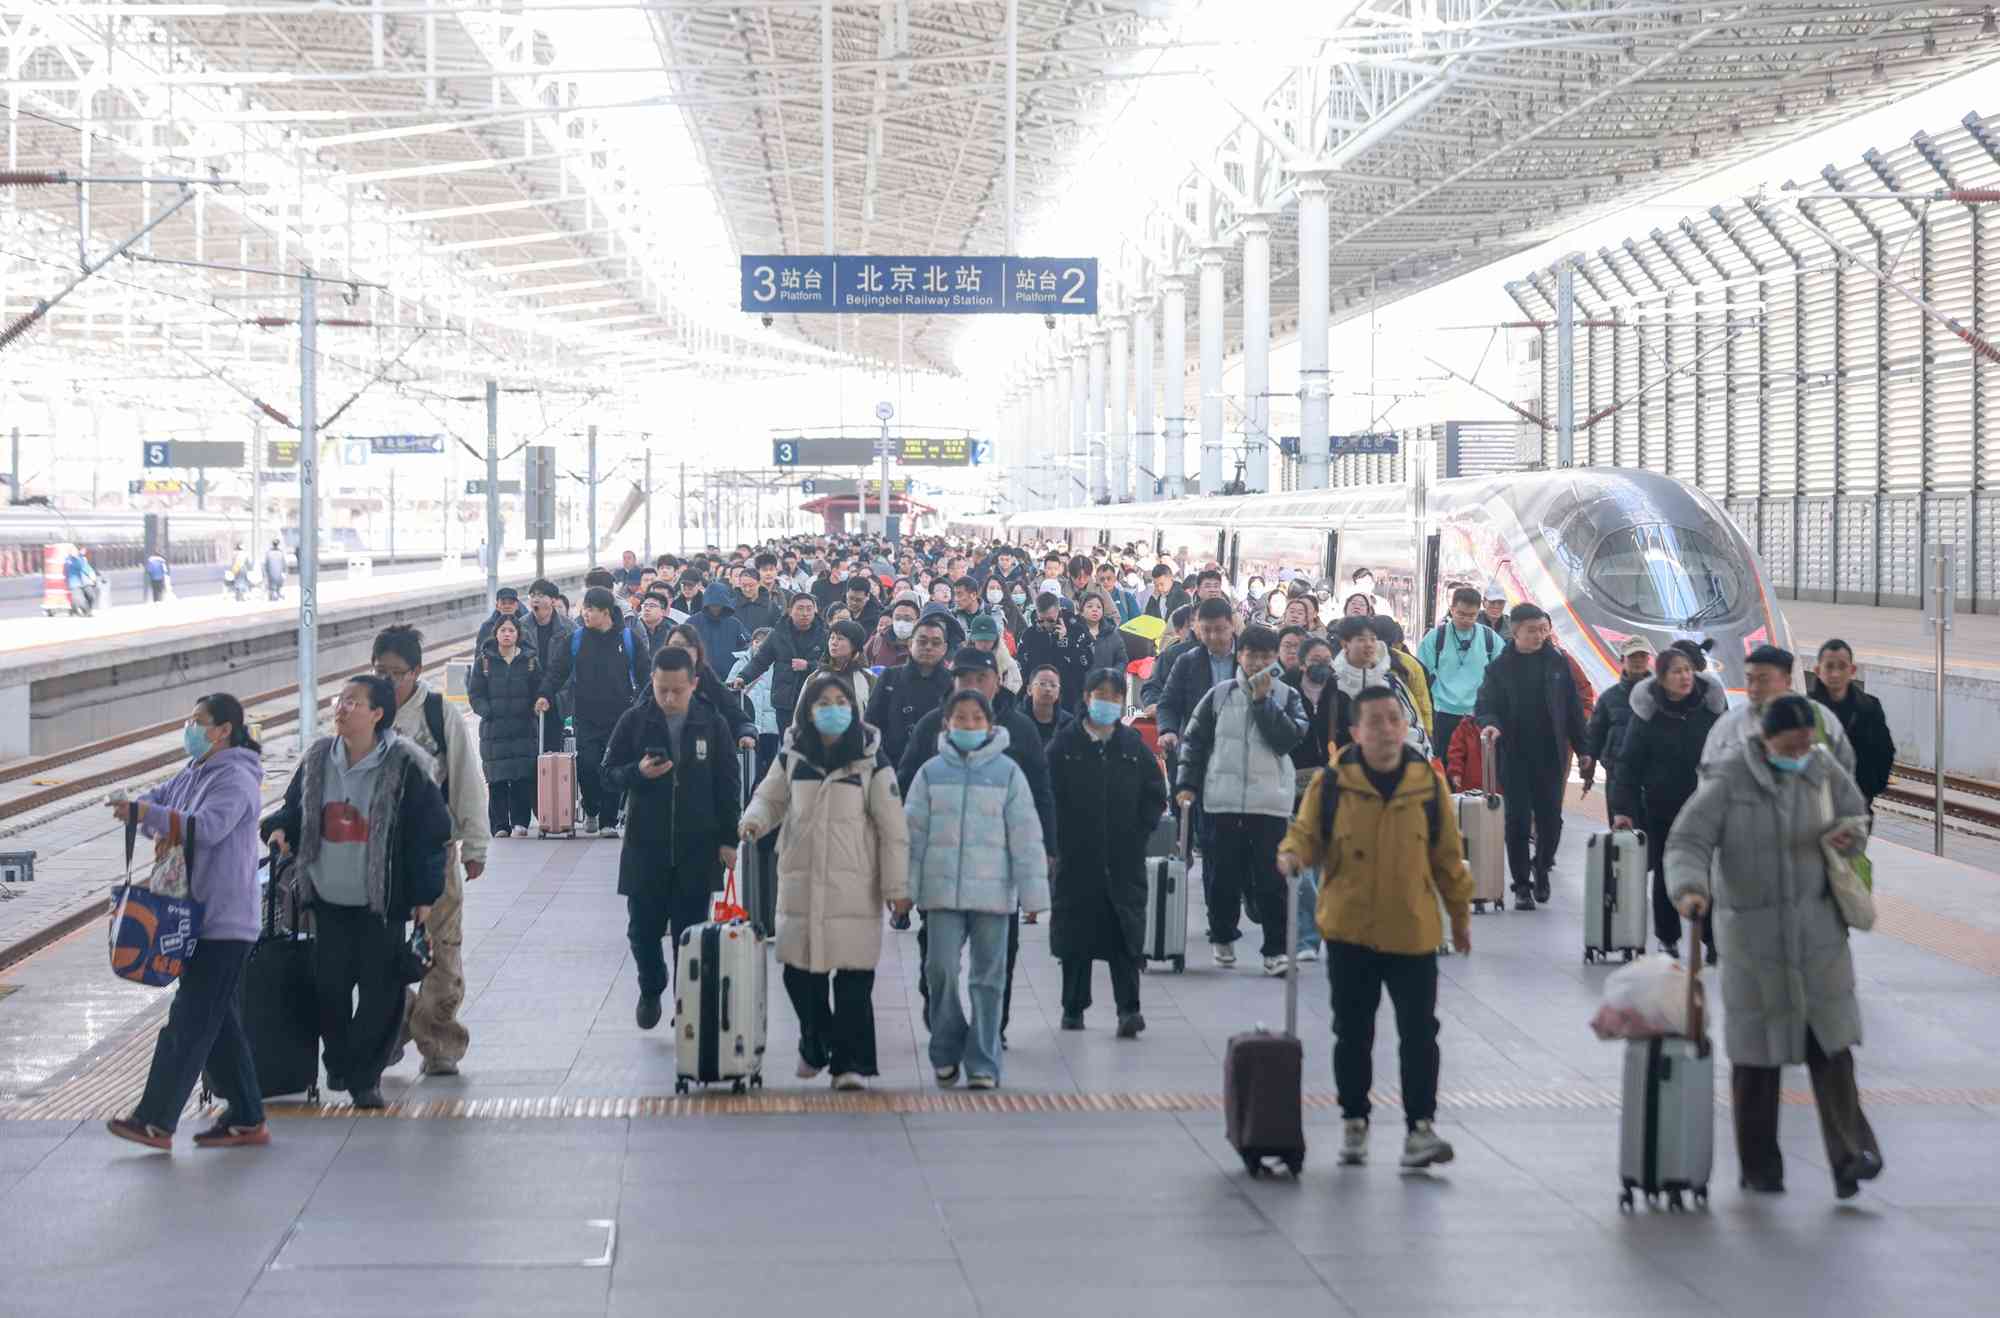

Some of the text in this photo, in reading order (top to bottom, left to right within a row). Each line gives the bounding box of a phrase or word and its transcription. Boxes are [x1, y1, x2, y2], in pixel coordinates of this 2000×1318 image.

[752, 266, 777, 301] 3
[780, 268, 823, 289] 站台
[856, 264, 983, 292] 北京北站
[1016, 269, 1057, 290] 站台
[1061, 267, 1086, 304] 2
[780, 290, 822, 301] Platform
[846, 294, 993, 307] Beijingbei Railway Station
[1015, 291, 1057, 302] Platform
[150, 445, 165, 464] 5
[779, 444, 793, 462] 3
[976, 443, 990, 464] 2
[805, 481, 814, 492] 3
